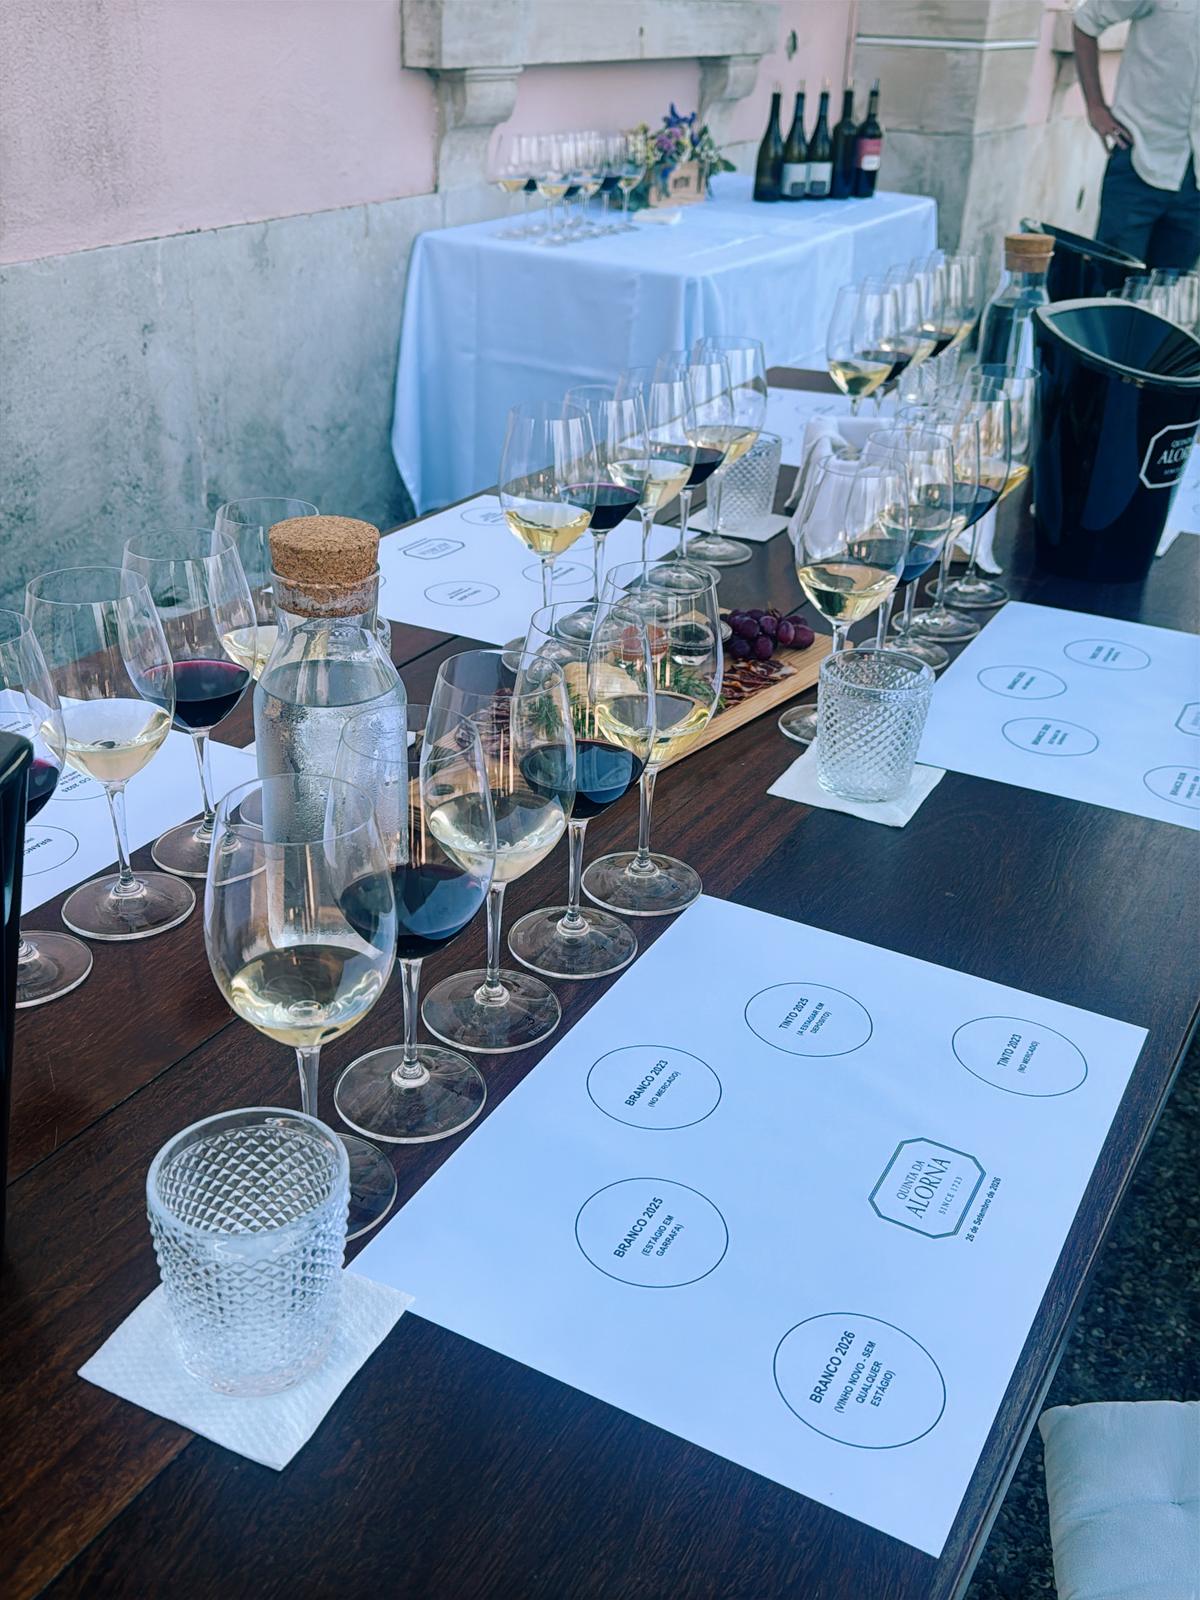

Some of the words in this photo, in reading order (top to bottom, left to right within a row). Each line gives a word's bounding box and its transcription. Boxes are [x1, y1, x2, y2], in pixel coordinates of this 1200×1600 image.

[24, 838, 52, 855] BRANC
[779, 1011, 798, 1029] TINTO
[793, 997, 809, 1012] 2025
[815, 1002, 824, 1011] EM
[997, 1048, 1014, 1067] TINTO
[1007, 1033, 1022, 1049] 2023
[1017, 1063, 1027, 1073] (NO
[1022, 1041, 1040, 1065] MERCADO)
[624, 1075, 655, 1107] BRANCO
[650, 1059, 668, 1076] 2023
[648, 1096, 659, 1108] (NO
[655, 1071, 681, 1097] MERCADO)
[896, 1172, 919, 1200] QUINTA
[911, 1160, 925, 1172] DA
[905, 1157, 951, 1219] ALORNA
[938, 1192, 955, 1215] SINCE
[951, 1176, 963, 1192] 1723
[986, 1189, 995, 1199] de
[989, 1176, 1002, 1192] 2026
[613, 1218, 648, 1258] BRANCO
[642, 1196, 663, 1219] 2025
[662, 1214, 674, 1226] EM
[970, 1224, 978, 1234] de
[973, 1198, 992, 1226] Setembro
[656, 1223, 685, 1257] GARRAFA)
[965, 1233, 975, 1242] 26
[809, 1356, 842, 1404] BRANCO
[834, 1330, 856, 1356] 2026
[834, 1385, 854, 1414] (VINHO
[848, 1362, 866, 1386] NOVO
[861, 1340, 877, 1358] SEM
[855, 1361, 883, 1404] QUALQUER
